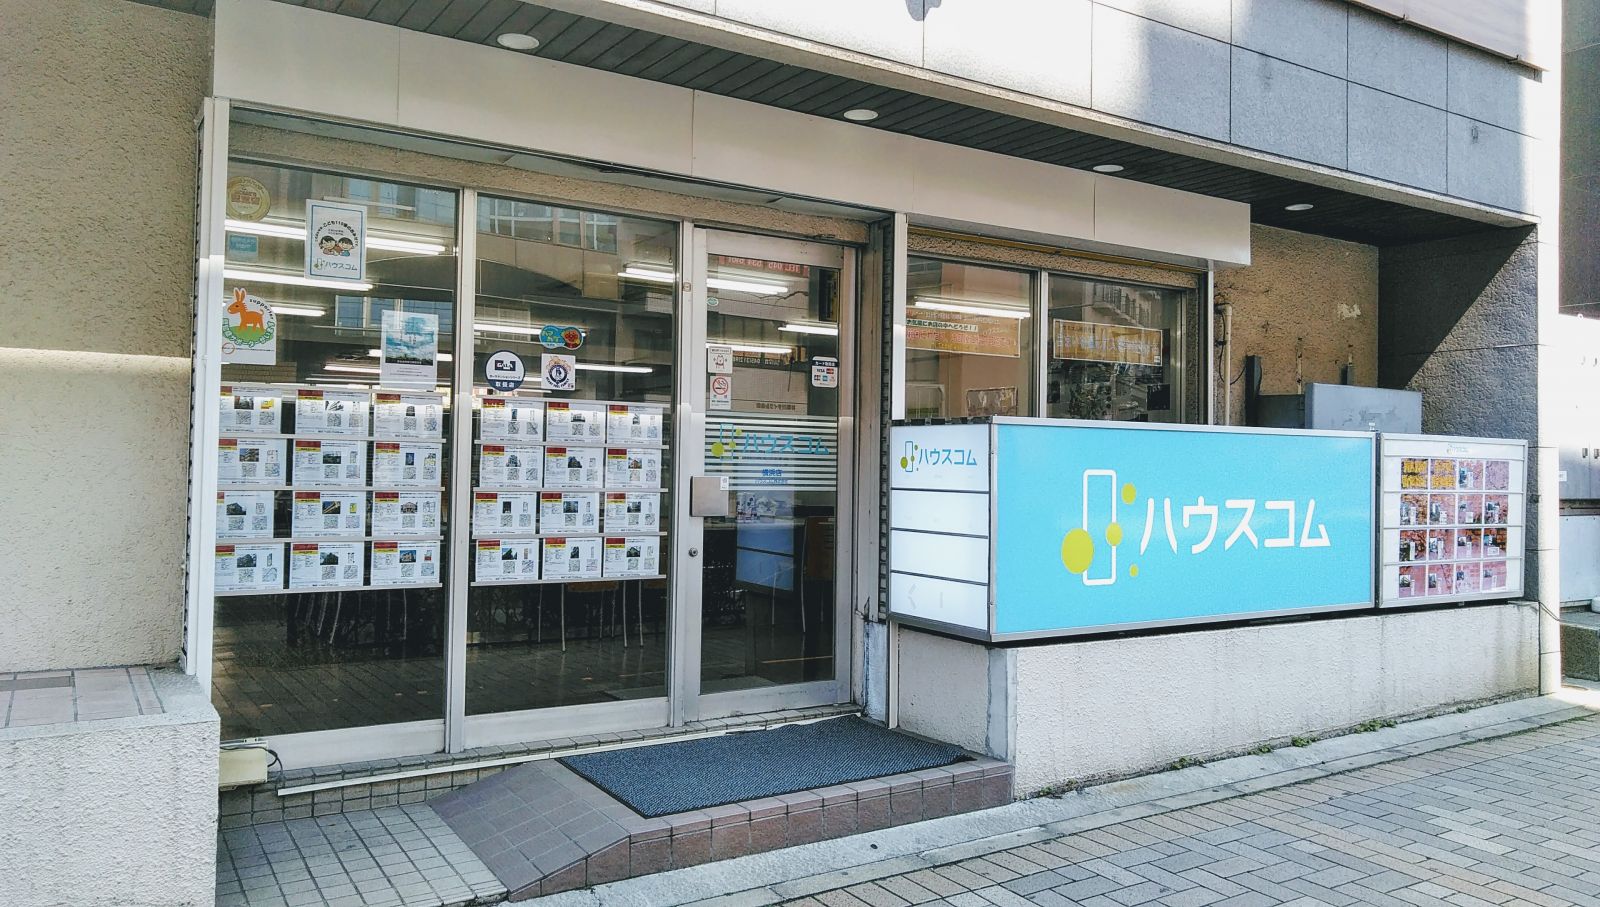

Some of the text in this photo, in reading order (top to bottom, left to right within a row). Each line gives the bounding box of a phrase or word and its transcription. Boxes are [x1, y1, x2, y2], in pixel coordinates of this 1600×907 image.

[325, 261, 358, 271] ハウスコム
[743, 433, 830, 455] ハウスコム
[918, 448, 978, 467] ハウスコム
[1140, 495, 1332, 555] ハウスコム
